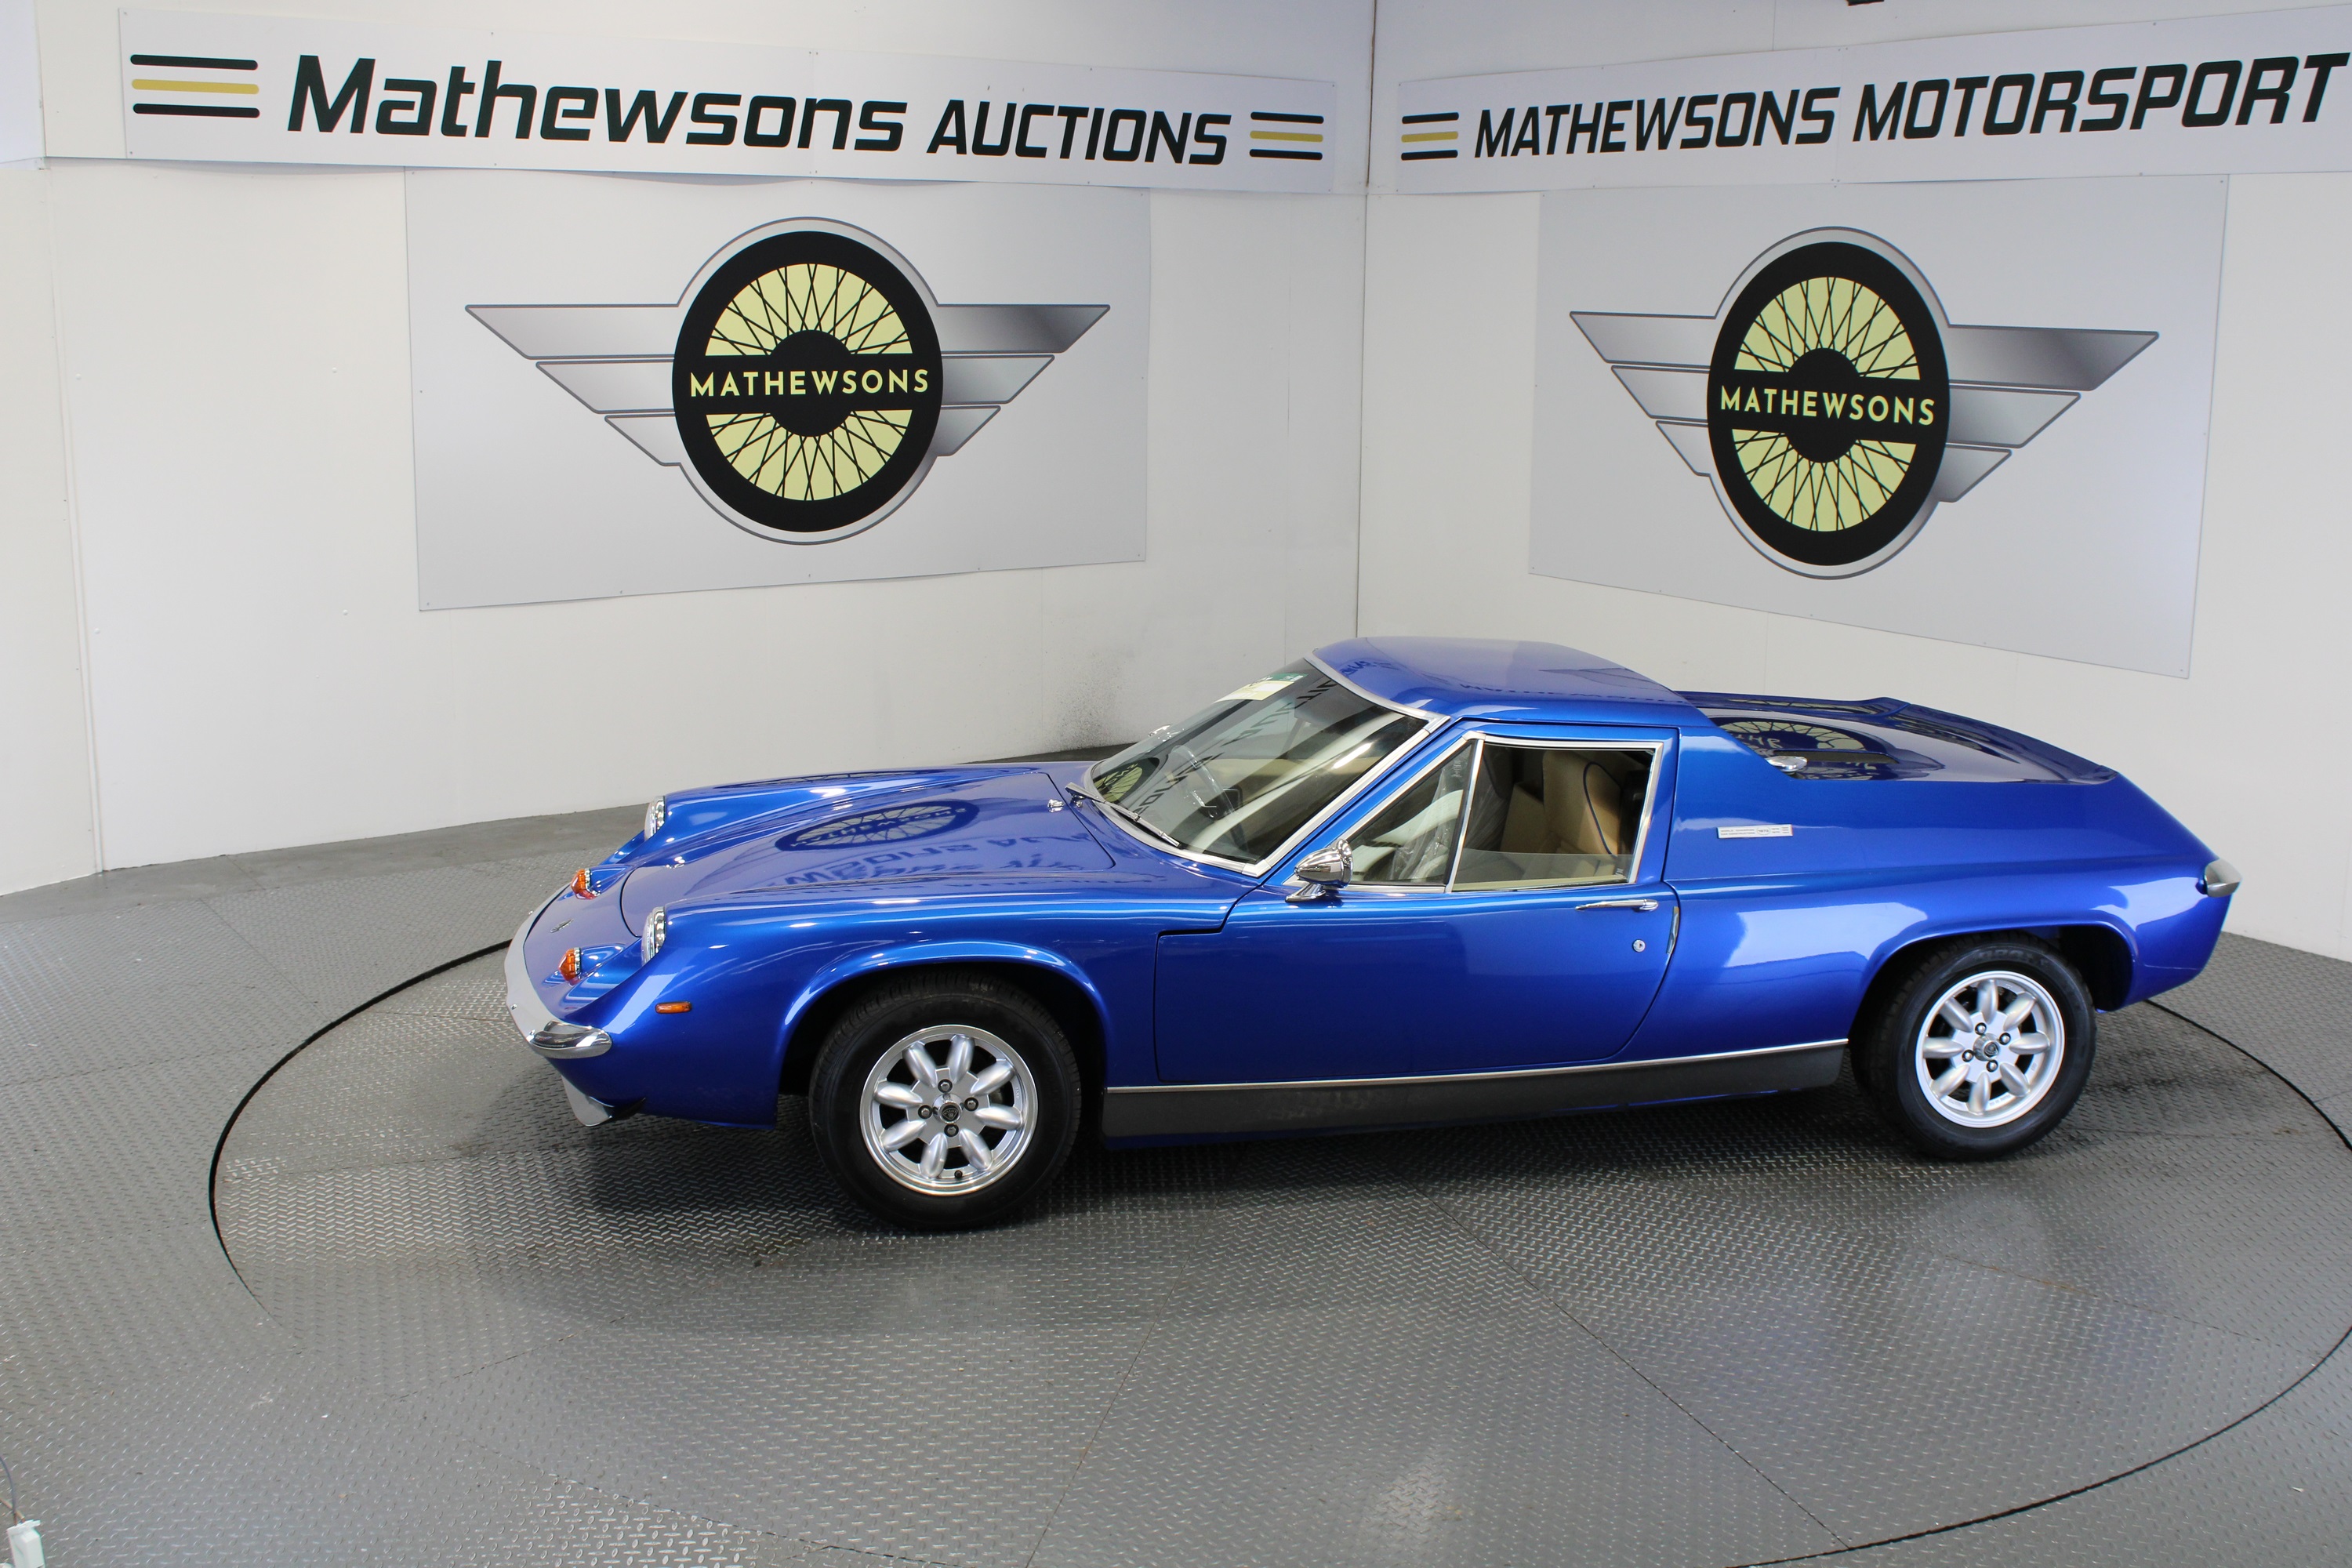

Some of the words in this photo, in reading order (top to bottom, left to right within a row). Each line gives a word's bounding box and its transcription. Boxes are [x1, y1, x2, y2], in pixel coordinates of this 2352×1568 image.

[288, 55, 907, 151] Mathewsons
[927, 100, 1231, 165] AUCTIONS
[1475, 87, 1840, 158] MATHEWSONS
[1853, 53, 2350, 141] MOTORSPORT
[690, 368, 928, 397] MATHEWSONS
[1721, 385, 1935, 426] MATHEWSONS
